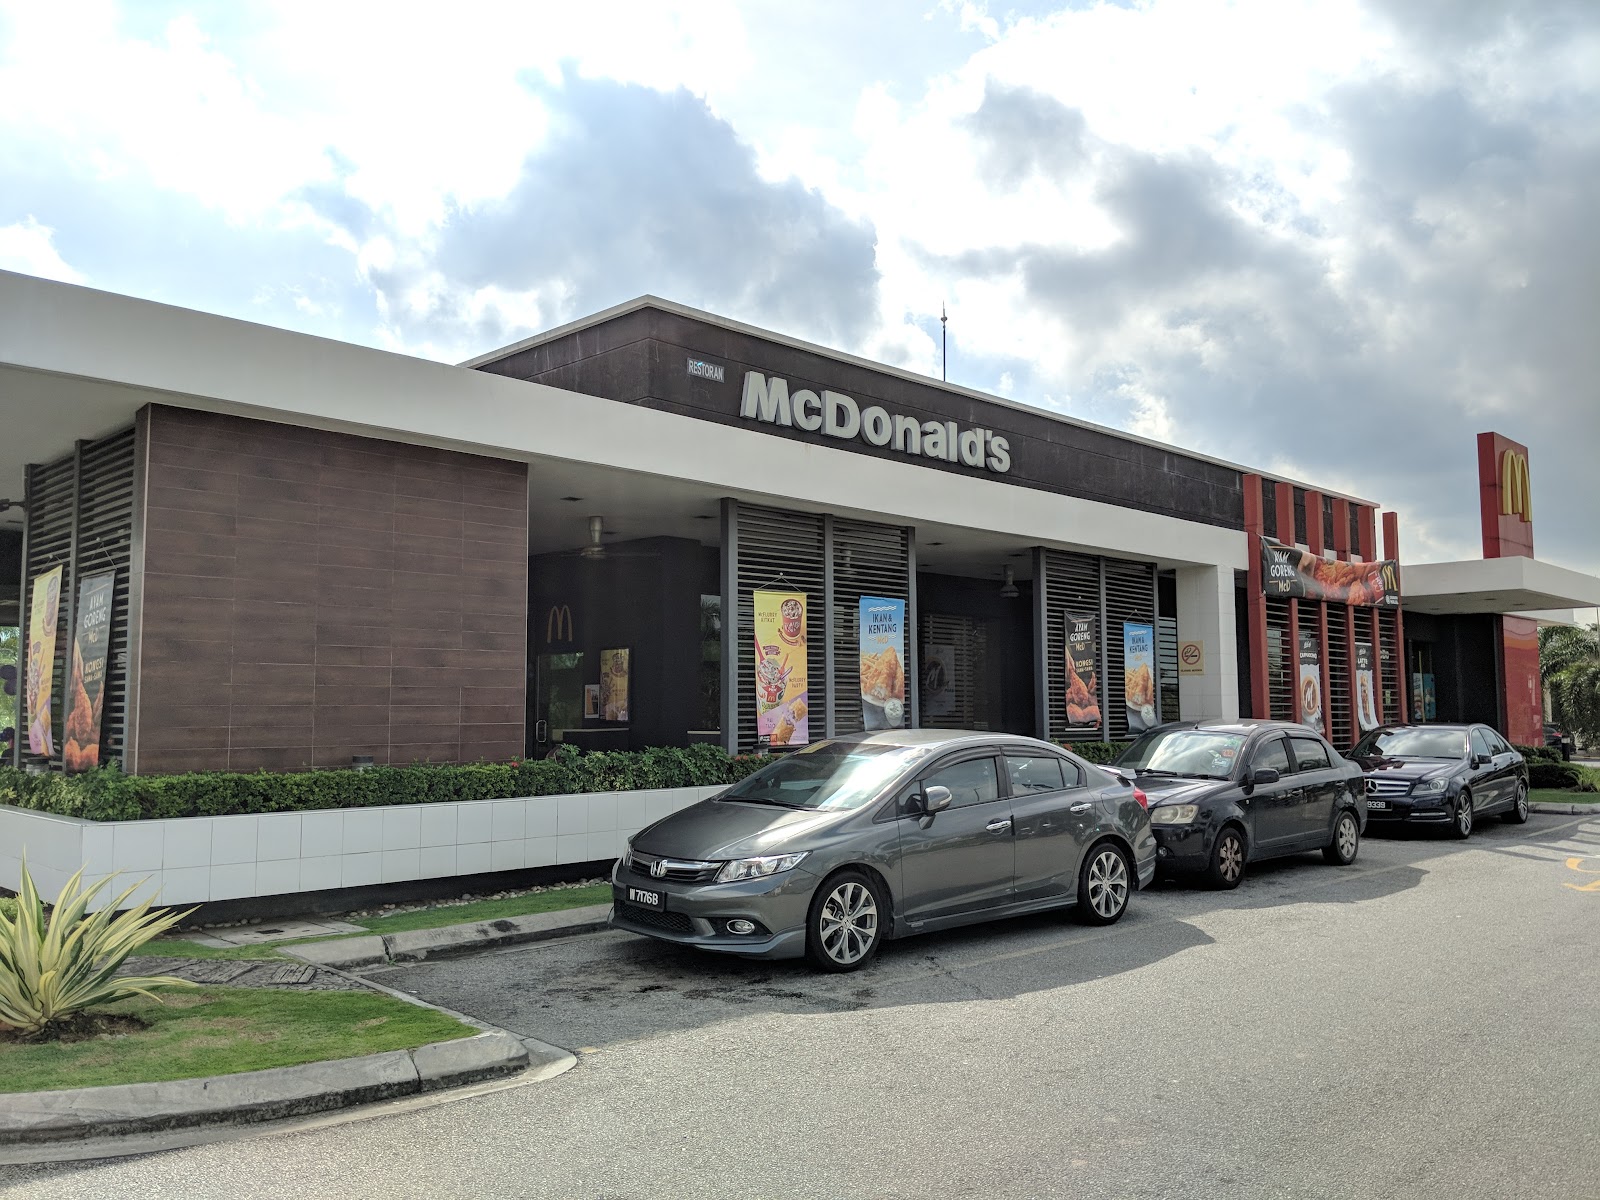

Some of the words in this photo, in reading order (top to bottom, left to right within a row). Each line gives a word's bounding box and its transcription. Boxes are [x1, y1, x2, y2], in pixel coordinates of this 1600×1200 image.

[688, 359, 723, 381] RESTORAN
[740, 370, 1011, 473] McDonald's
[1278, 580, 1291, 592] McD
[83, 606, 107, 629] GORENG
[868, 623, 897, 635] KENTANG
[1069, 631, 1091, 642] GORENG
[1075, 642, 1086, 652] McD
[630, 888, 635, 900] W
